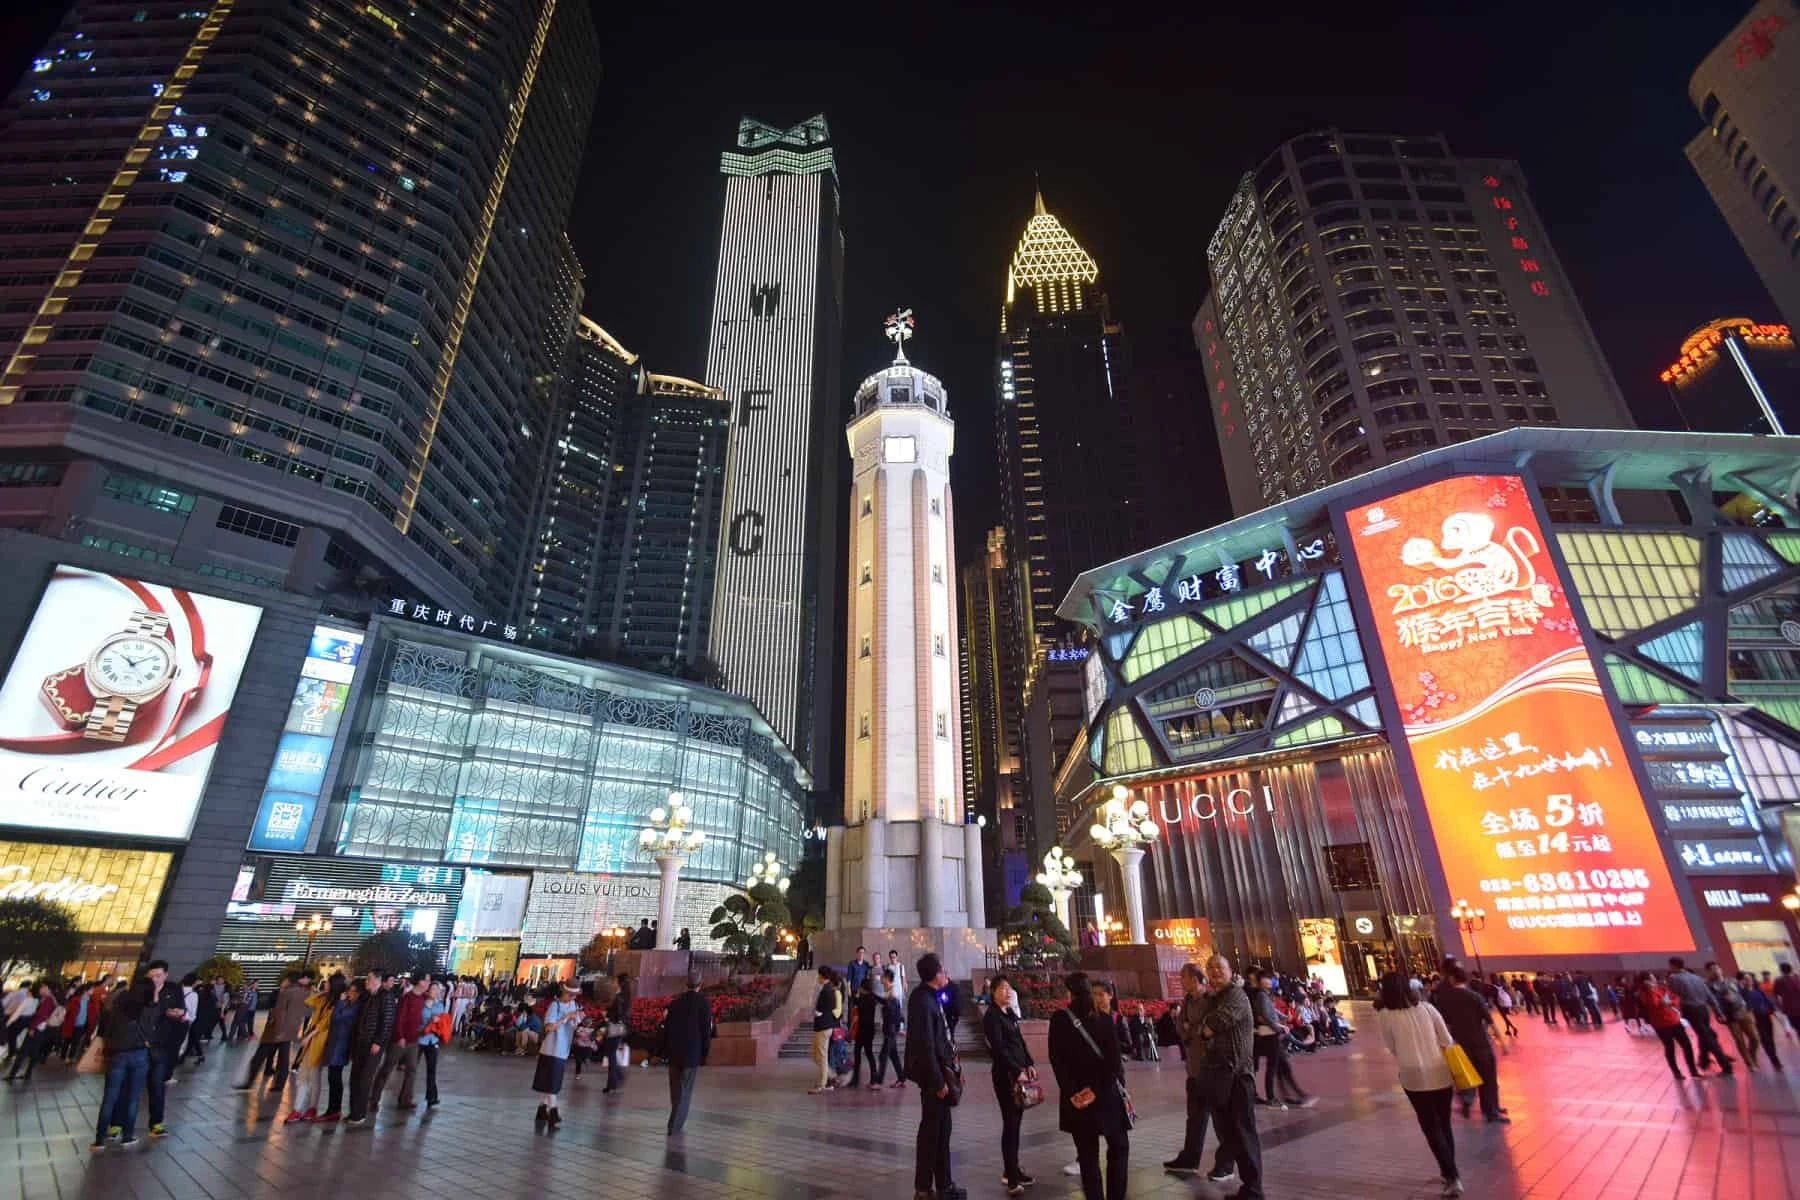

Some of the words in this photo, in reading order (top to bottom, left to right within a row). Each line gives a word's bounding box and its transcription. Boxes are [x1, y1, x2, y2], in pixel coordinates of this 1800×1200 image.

[1107, 538, 1325, 624] 金鹰财富中心
[1386, 575, 1463, 615] 2016
[387, 597, 518, 641] 重庆时代广场
[1395, 597, 1545, 649] 猴年吉祥
[1467, 629, 1499, 645] New
[18, 765, 148, 802] Cartier
[1159, 785, 1275, 825] UCCI
[292, 882, 398, 905] Ermenegildo
[398, 886, 448, 906] Zegna
[543, 881, 587, 896] LOUIS
[593, 882, 652, 898] VUITTON
[1703, 889, 1744, 908] MUJI
[1154, 927, 1201, 939] GUCCI
